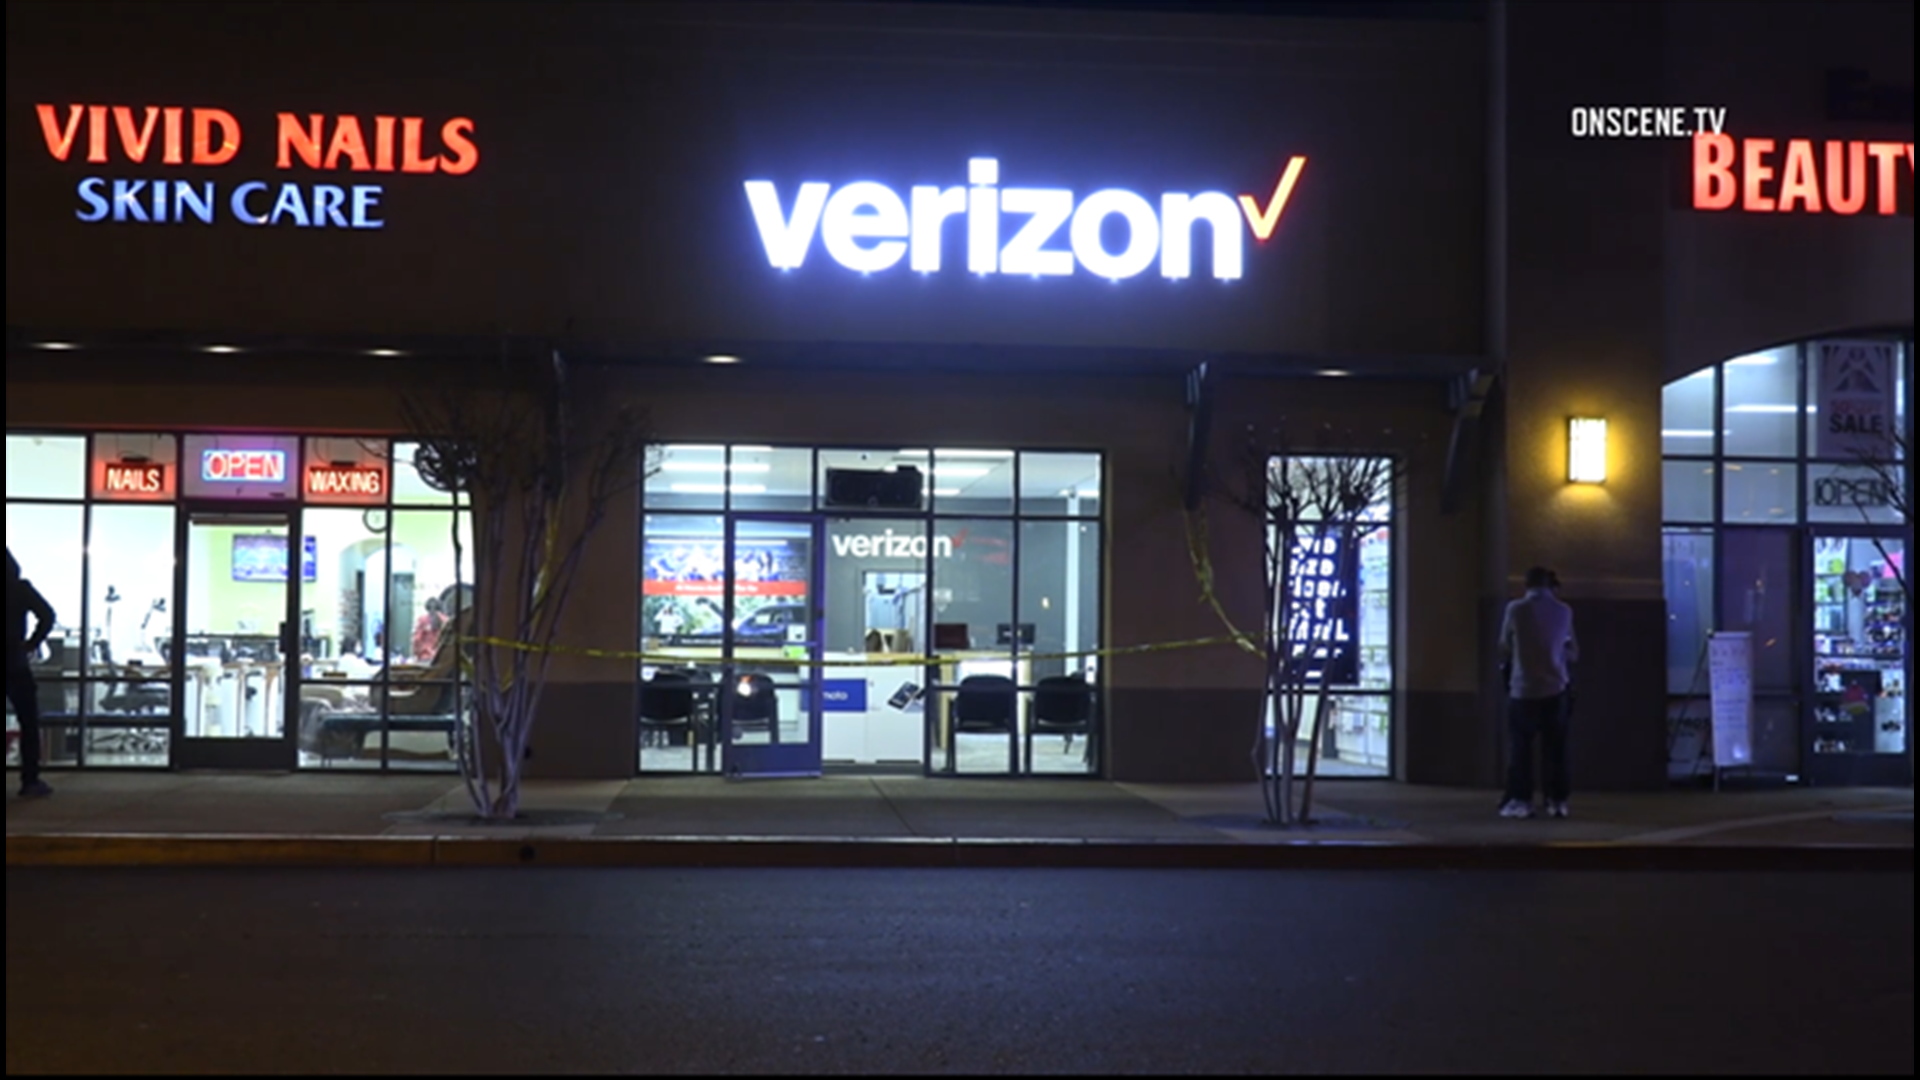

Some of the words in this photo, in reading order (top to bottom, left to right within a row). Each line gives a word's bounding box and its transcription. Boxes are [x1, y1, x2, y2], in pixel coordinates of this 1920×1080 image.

[36, 104, 241, 164] VIVID
[276, 112, 478, 174] NAILS
[1693, 131, 1914, 214] BEAUT
[76, 178, 214, 223] SKIN
[231, 180, 384, 228] CARE
[744, 158, 1243, 279] verizon
[1829, 413, 1883, 434] SALE
[107, 467, 160, 491] NAILS
[207, 453, 281, 478] OPEN
[309, 470, 380, 494] WAXING
[1818, 478, 1888, 505] OPEN
[832, 529, 952, 558] verizon
